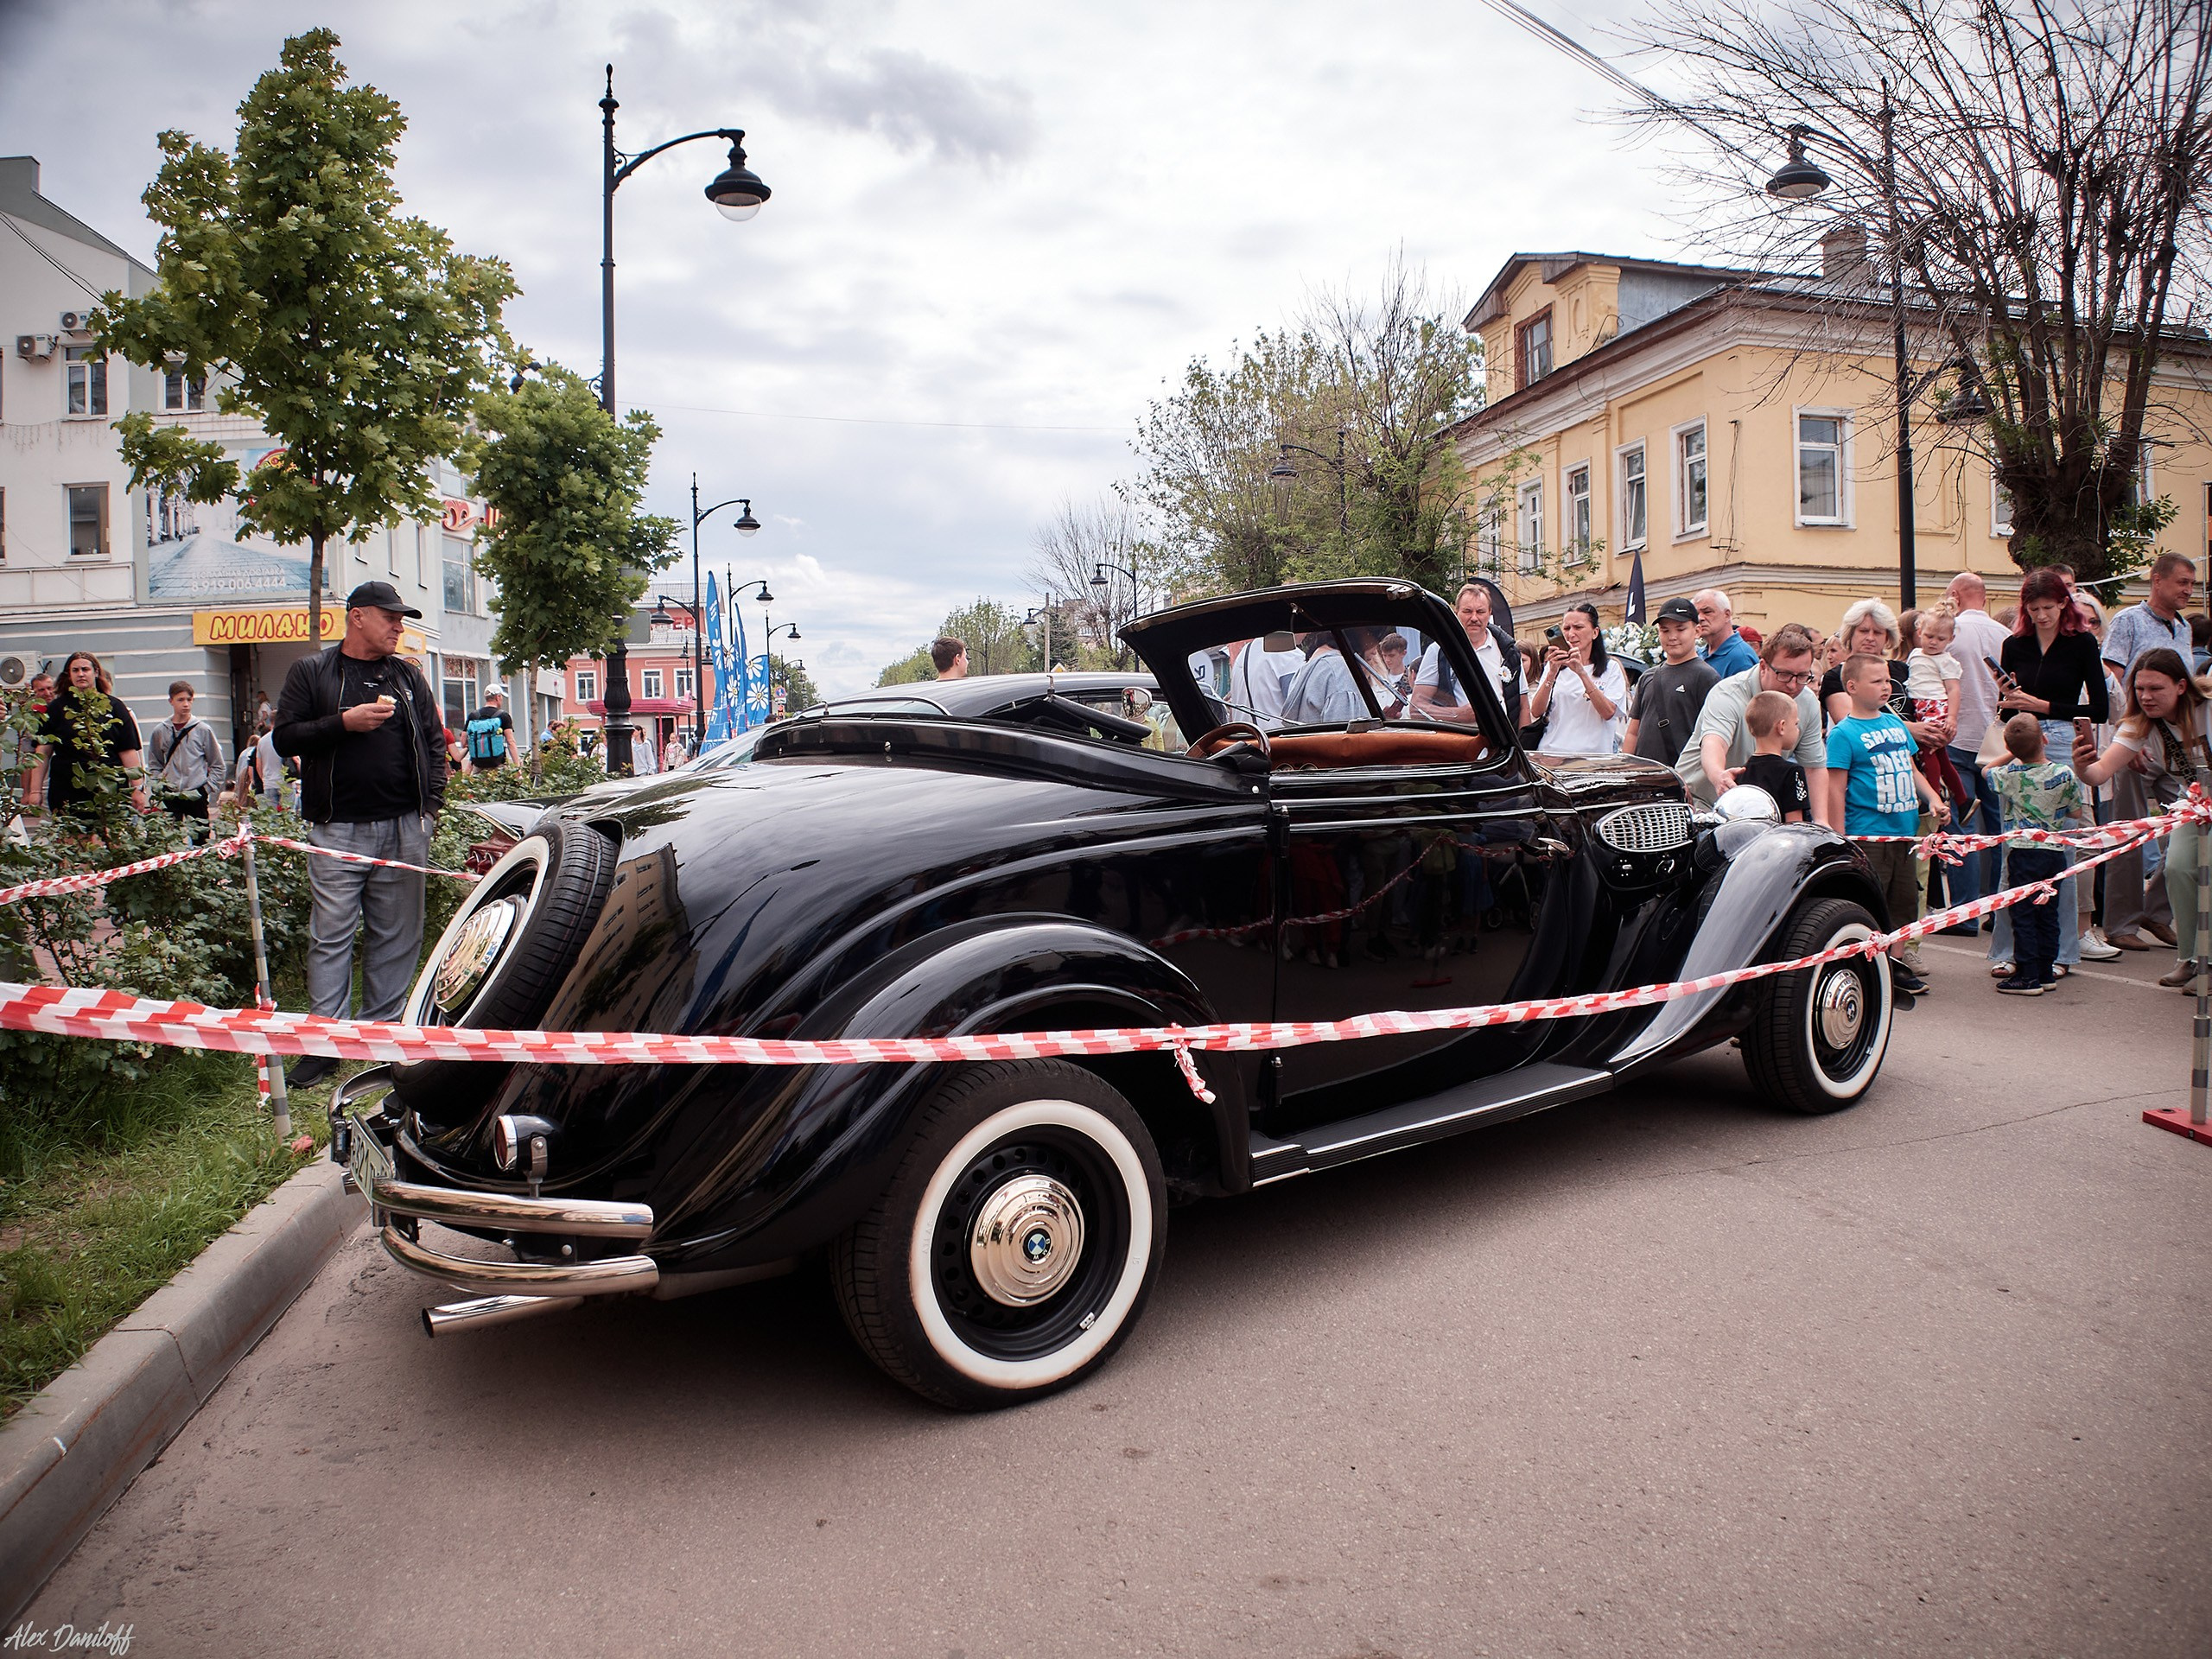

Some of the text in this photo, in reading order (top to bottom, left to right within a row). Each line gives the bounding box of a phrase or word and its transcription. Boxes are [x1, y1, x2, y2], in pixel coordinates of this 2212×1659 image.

[243, 569, 285, 577] ДОСТАВКА
[192, 576, 286, 592] 8 919 006 4444
[210, 612, 334, 640] МИЛАНО
[1870, 749, 1913, 774] WEE
